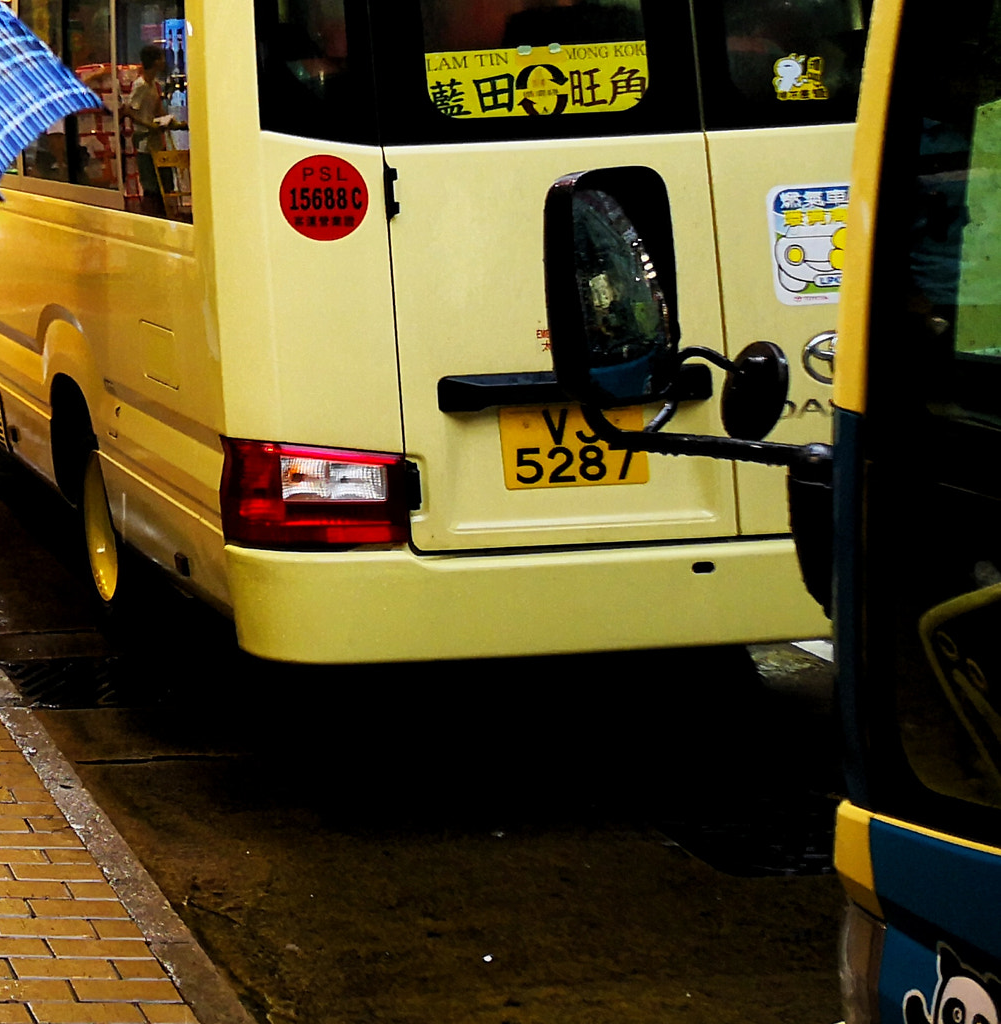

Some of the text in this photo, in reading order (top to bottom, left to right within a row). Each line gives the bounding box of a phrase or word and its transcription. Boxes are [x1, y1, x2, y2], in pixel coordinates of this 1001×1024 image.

[426, 57, 468, 72] LAM
[474, 52, 510, 67] TIN
[614, 43, 646, 58] KOK
